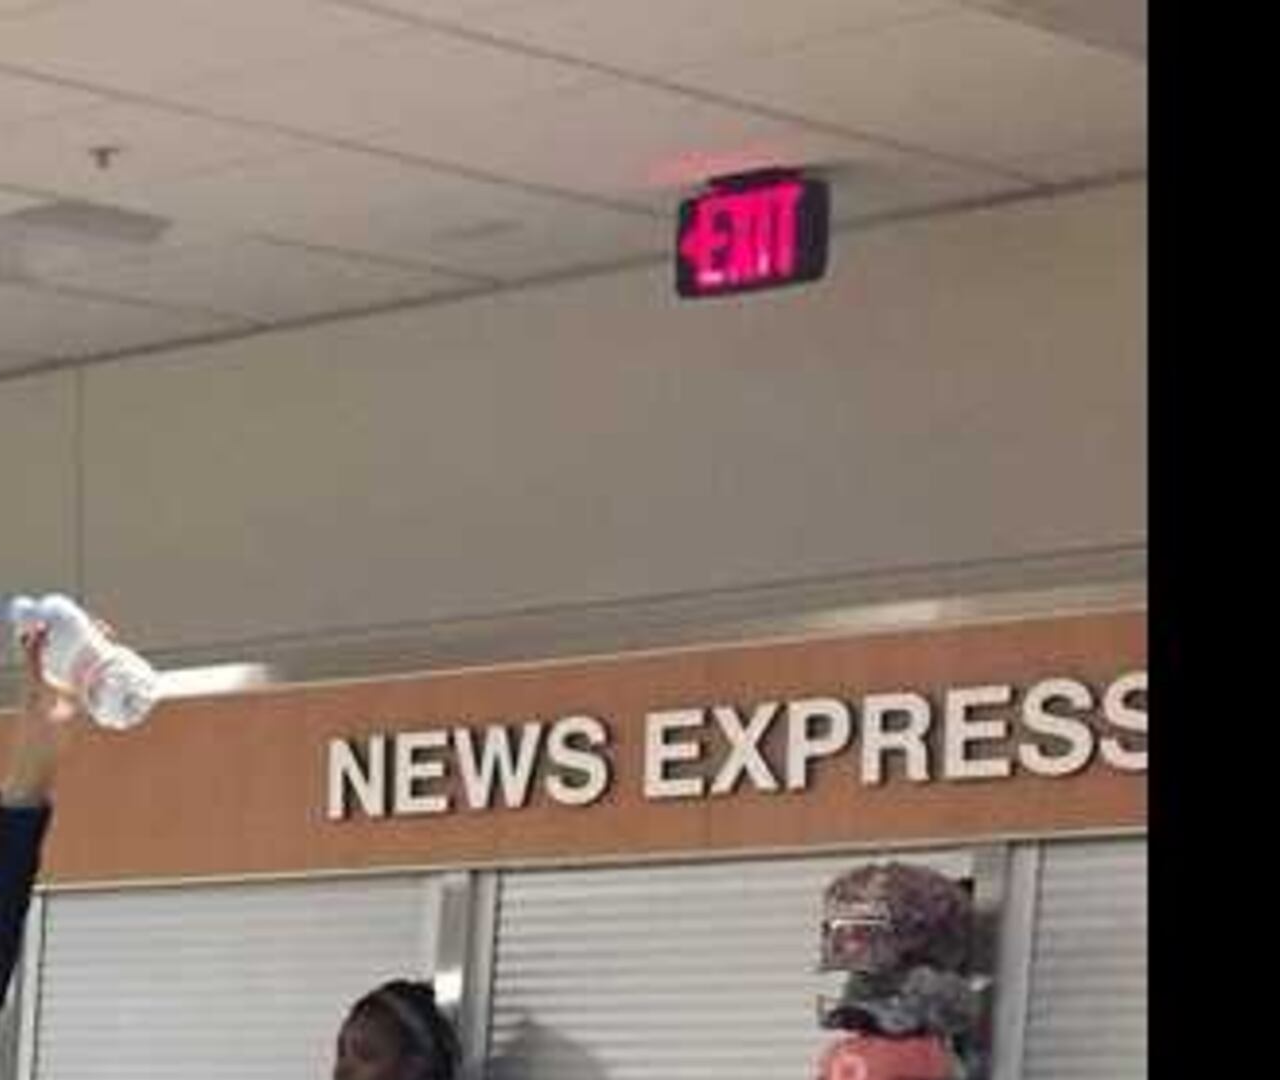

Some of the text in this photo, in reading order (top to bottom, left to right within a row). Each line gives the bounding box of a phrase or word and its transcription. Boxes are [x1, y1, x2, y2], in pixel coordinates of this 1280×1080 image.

[696, 184, 799, 284] EXIT
[325, 669, 1148, 820] NEWS EXPRESS
